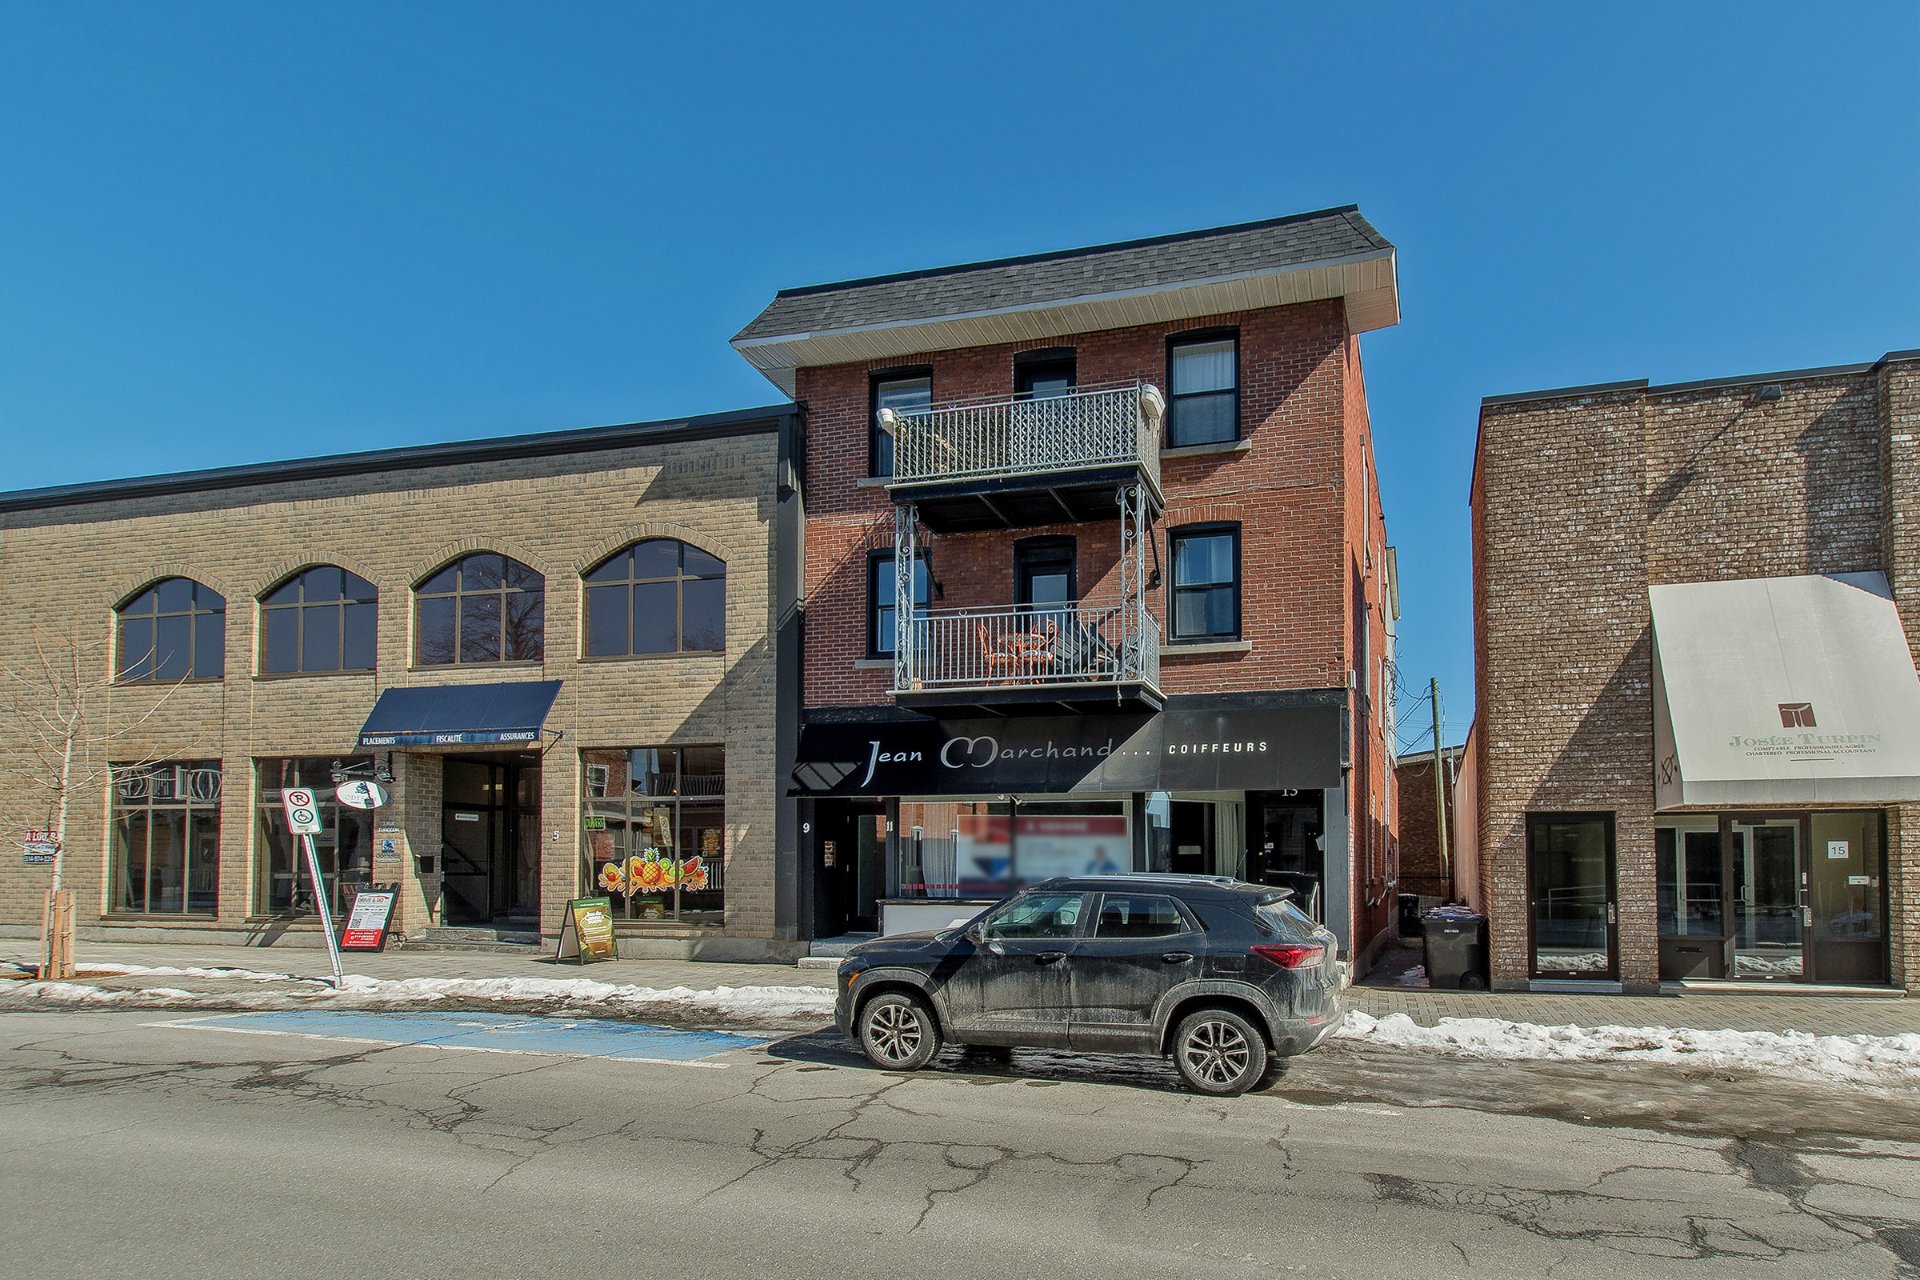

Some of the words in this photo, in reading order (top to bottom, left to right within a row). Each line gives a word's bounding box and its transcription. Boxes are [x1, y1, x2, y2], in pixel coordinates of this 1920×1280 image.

[362, 736, 396, 745] PLACEMENTS
[435, 733, 462, 743] FISCALITÉ
[500, 731, 535, 741] ASSURANCES
[1728, 735, 1794, 747] JOSÉE
[1797, 733, 1882, 745] TURPIN
[860, 741, 922, 788] Jean
[1168, 741, 1267, 754] COIFFEURS
[803, 823, 810, 833] 9
[886, 821, 894, 832] 11
[33, 832, 58, 841] LOUR
[552, 831, 560, 841] 5
[1831, 846, 1846, 855] 15
